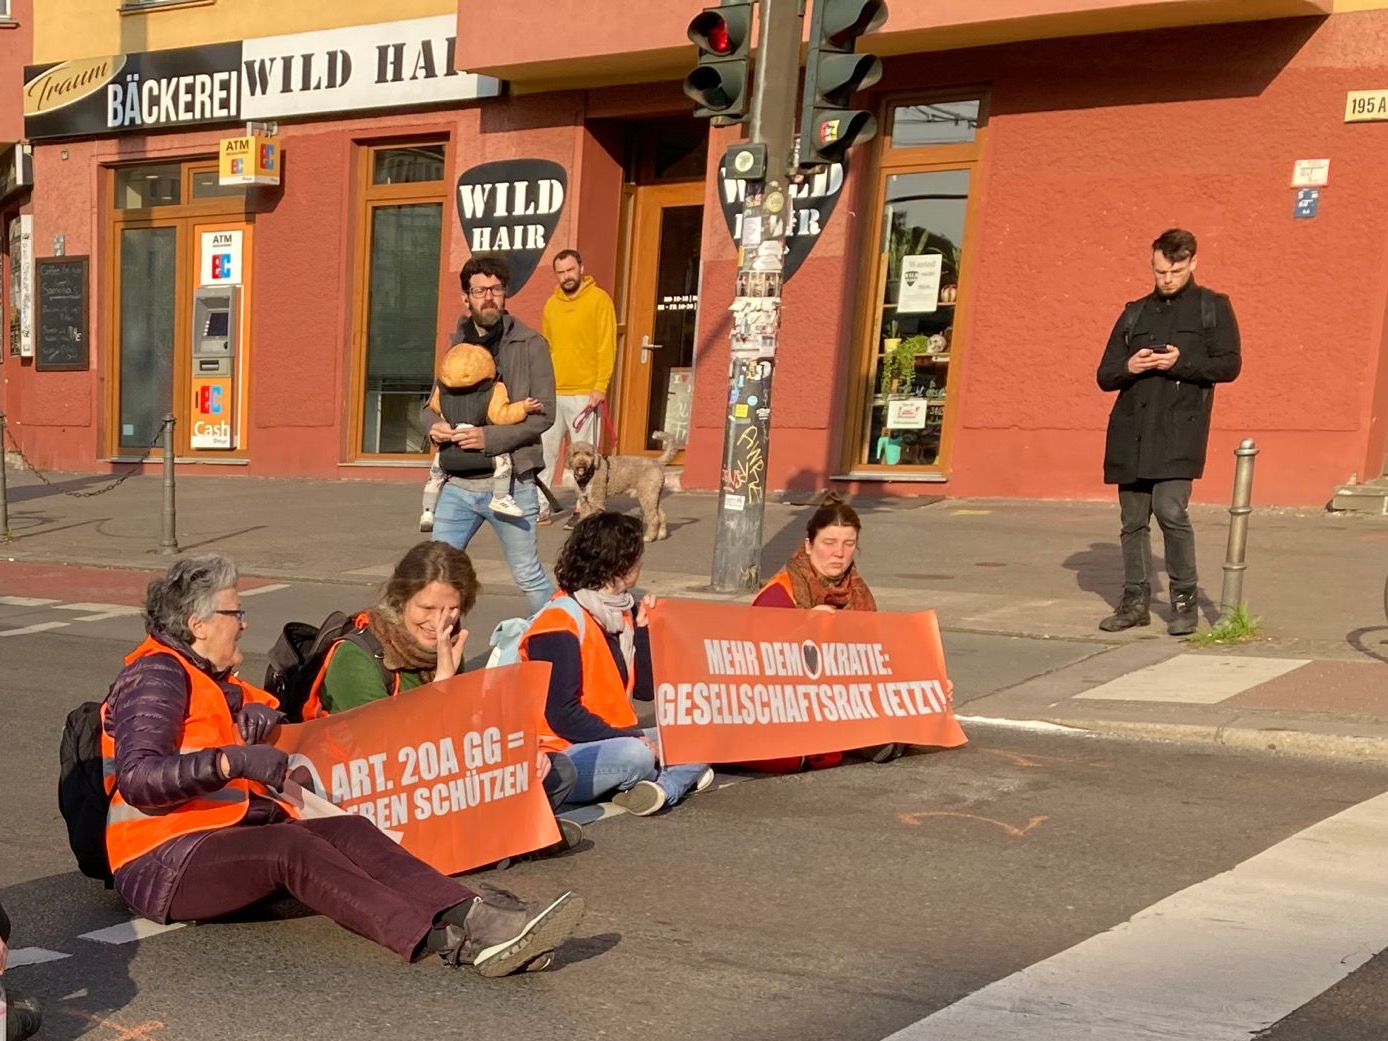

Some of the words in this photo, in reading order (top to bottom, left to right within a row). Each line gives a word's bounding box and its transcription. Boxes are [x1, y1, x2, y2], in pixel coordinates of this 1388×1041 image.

[28, 62, 110, 110] Traum
[243, 49, 352, 97] WILD
[107, 70, 238, 128] BÄCKEREI
[1352, 98, 1375, 114] 195
[1378, 97, 1387, 113] A
[226, 139, 249, 151] ATM
[459, 179, 564, 219] WILD
[212, 234, 232, 243] ATM
[471, 224, 546, 251] HAIR
[194, 419, 230, 437] Cash
[704, 639, 760, 676] MEHR
[657, 682, 879, 726] GESELLSCHAFTSRAT
[877, 680, 947, 717] JETZT!
[331, 752, 394, 804] ART.
[398, 737, 459, 786] 20A
[463, 727, 502, 770] GG
[413, 762, 530, 820] SCHÜTZEN
